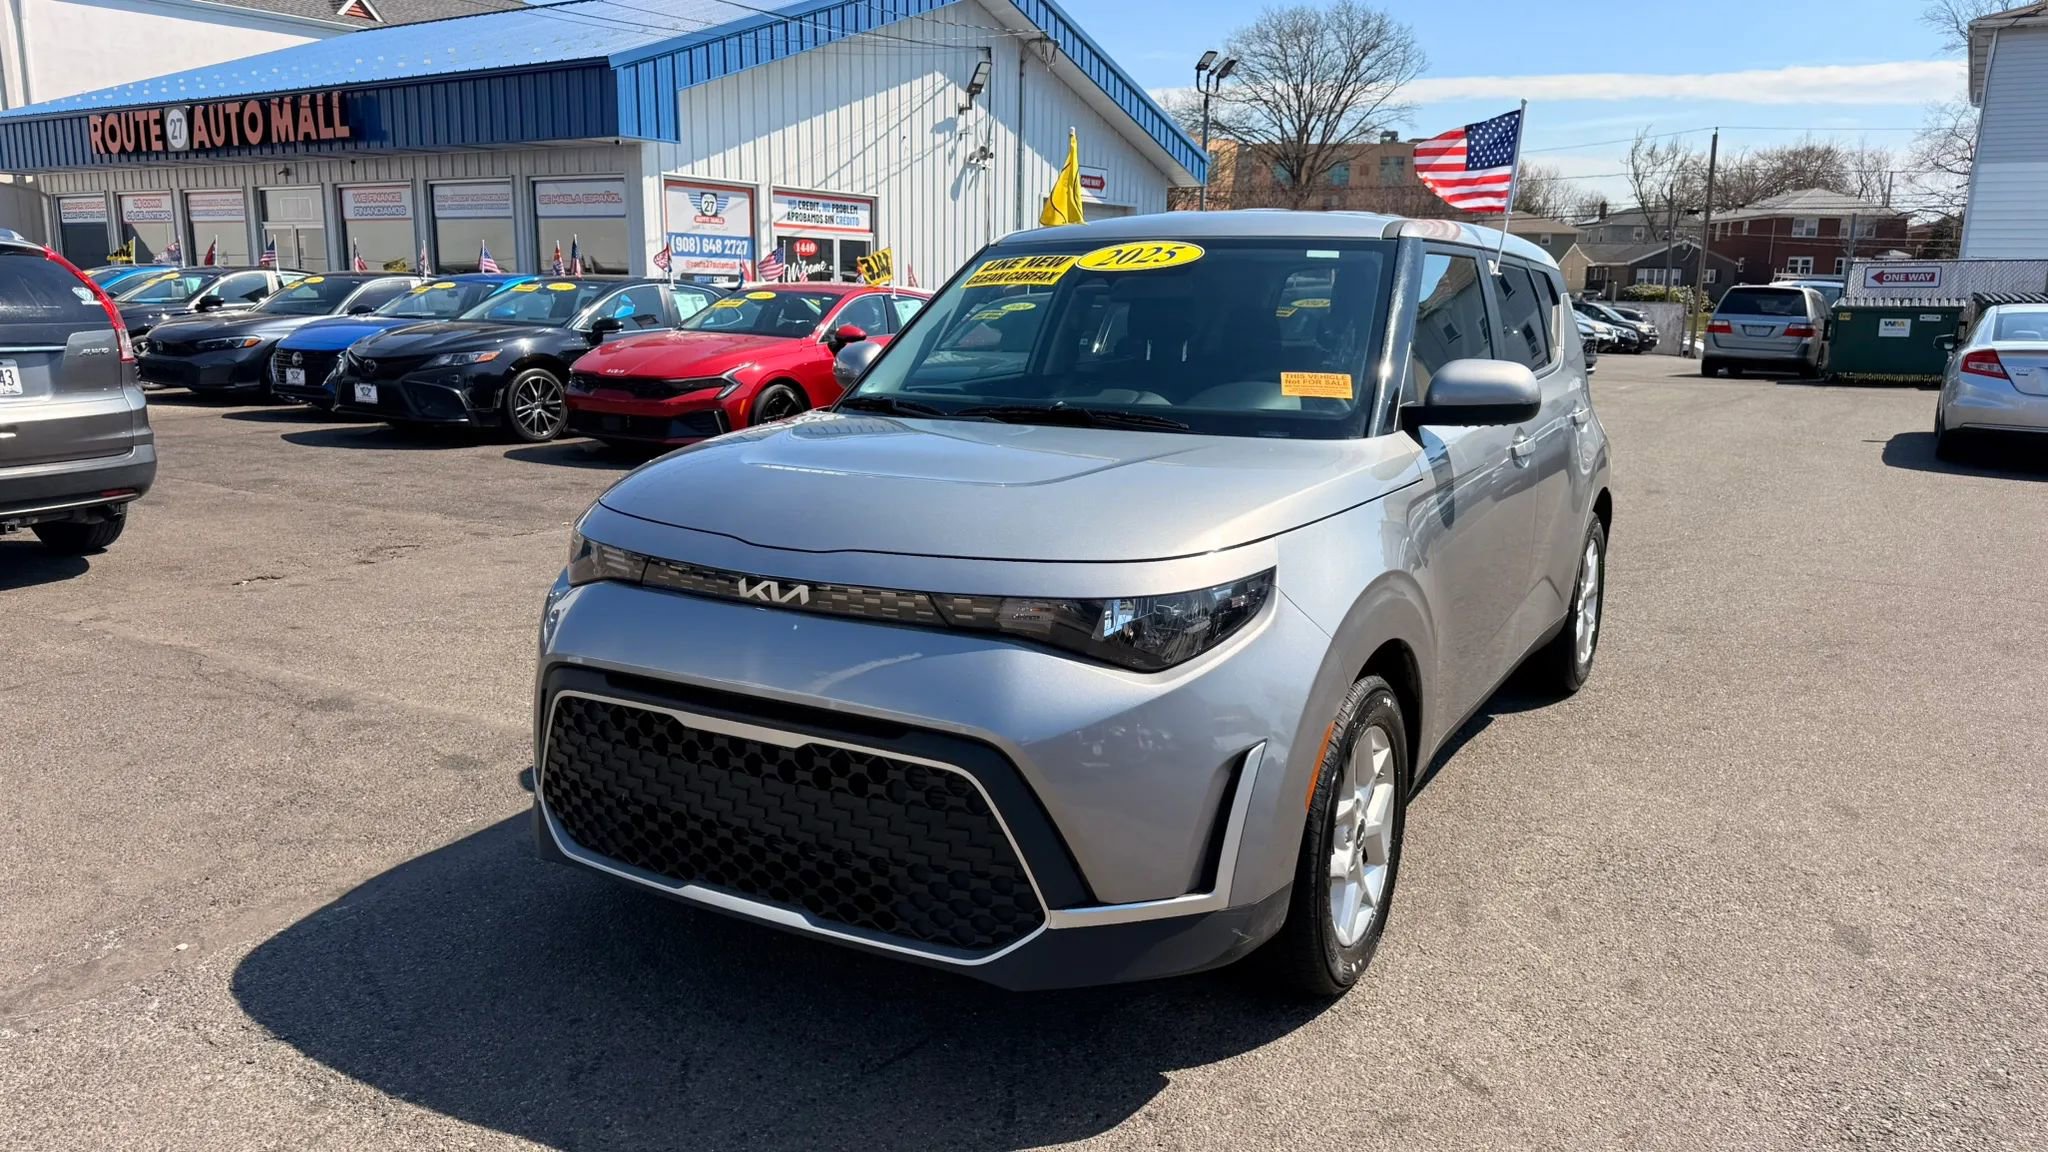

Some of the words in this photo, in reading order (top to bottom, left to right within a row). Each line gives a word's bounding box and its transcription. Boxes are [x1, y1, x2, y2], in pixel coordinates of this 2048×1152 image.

[89, 109, 163, 155] ROUTE
[169, 118, 183, 140] 27
[193, 100, 264, 150] AUTO
[270, 91, 350, 144] MALL
[353, 193, 368, 203] WE
[368, 192, 401, 203] FINANCE
[539, 194, 551, 205] SE
[551, 193, 580, 205] HABLA
[581, 190, 623, 204] ESPAÑOL
[354, 205, 406, 216] FINANCIAMOS
[704, 200, 715, 212] 27
[831, 203, 858, 214] PROBLEM
[787, 211, 823, 224] APROBAMOS
[671, 235, 700, 254] (908)
[702, 238, 722, 254] 648
[724, 239, 748, 255] 2727
[795, 242, 816, 252] 1440
[1095, 246, 1185, 267] 2025
[983, 258, 1021, 272] LIKE
[1021, 256, 1069, 269] NEW
[968, 271, 1007, 284] CLEAN
[1004, 271, 1060, 283] CARFAX
[1883, 273, 1906, 281] ONE
[1907, 273, 1933, 281] WAY
[738, 577, 810, 605] KIA
